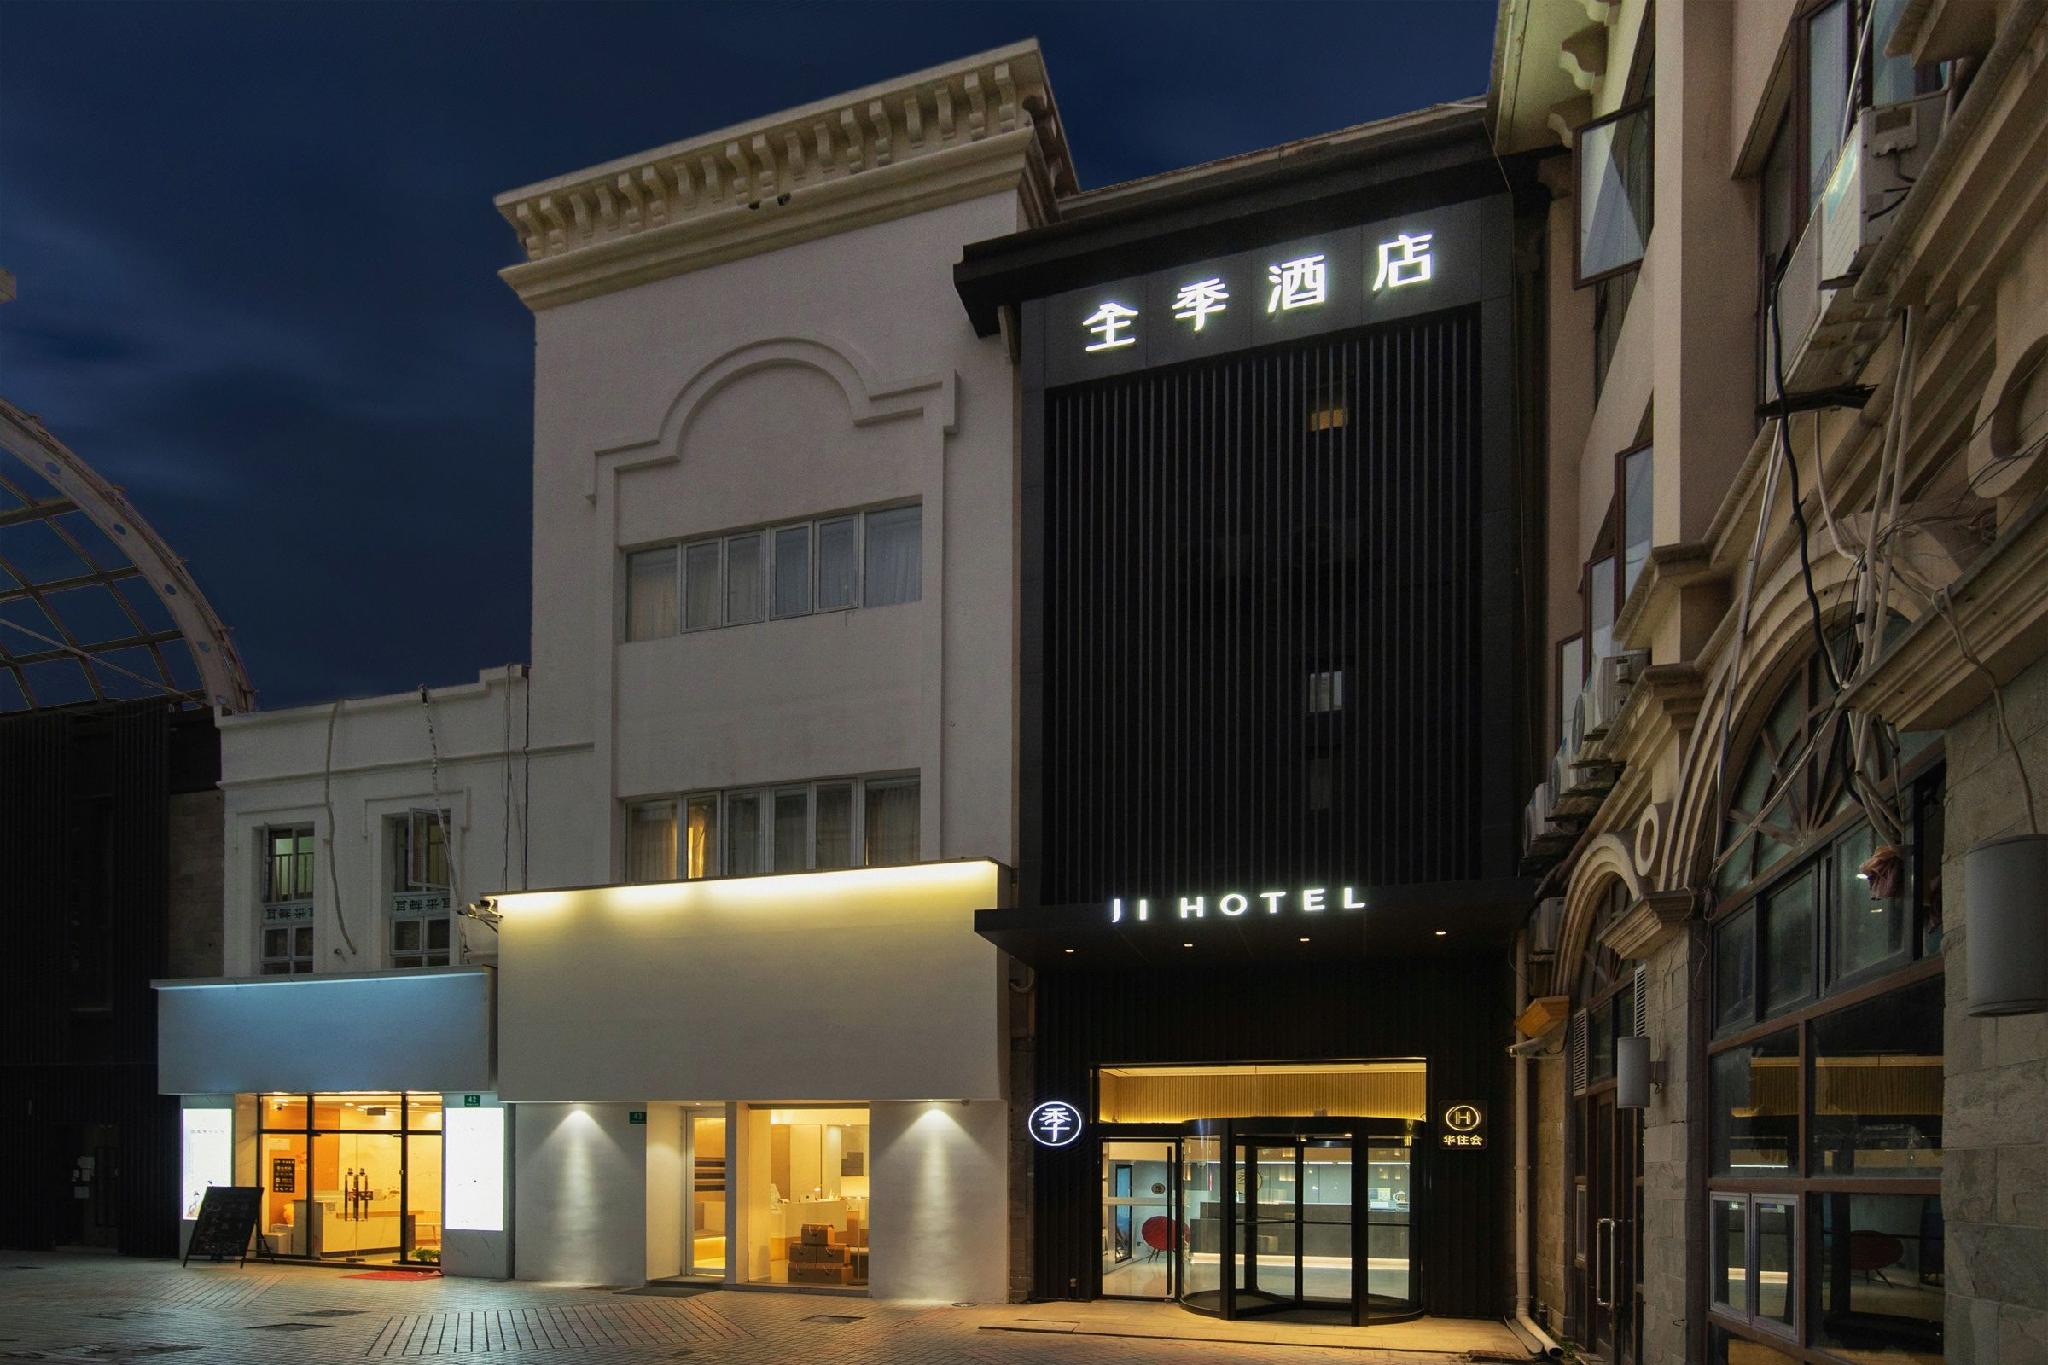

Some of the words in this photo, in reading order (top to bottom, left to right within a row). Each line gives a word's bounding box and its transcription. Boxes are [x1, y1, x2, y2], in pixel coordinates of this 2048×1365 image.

[1082, 233, 1434, 353] 全季酒店
[1111, 897, 1149, 923] JI
[1179, 886, 1366, 919] HOTEL
[1039, 1107, 1071, 1141] 季
[1443, 1134, 1483, 1146] 华住会
